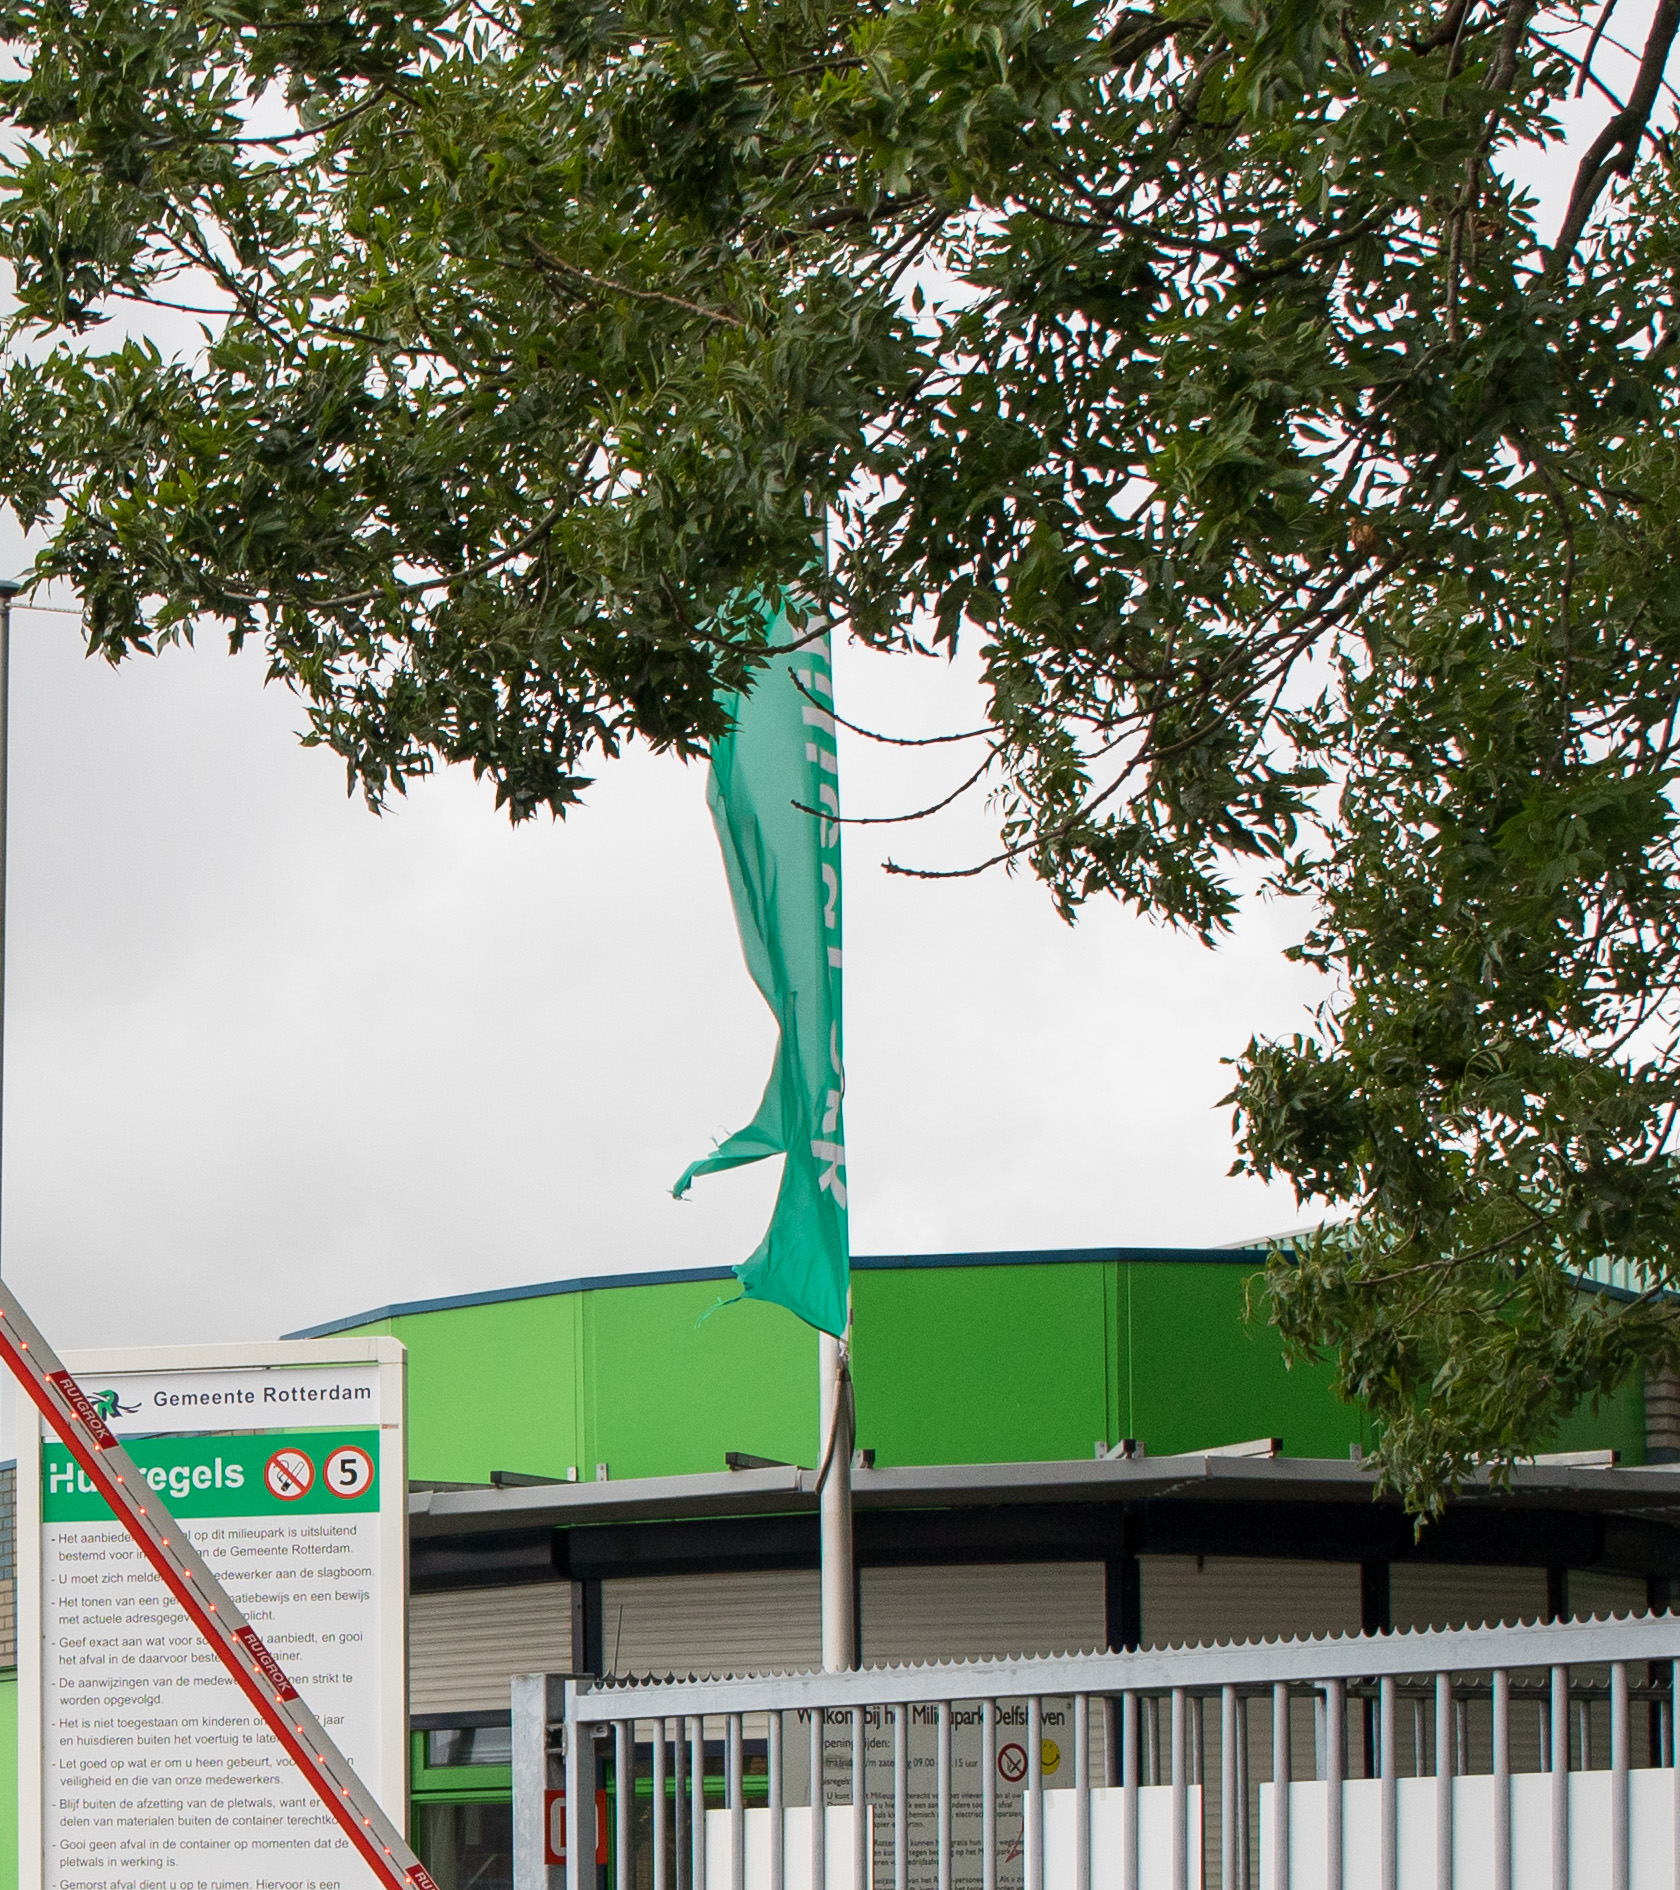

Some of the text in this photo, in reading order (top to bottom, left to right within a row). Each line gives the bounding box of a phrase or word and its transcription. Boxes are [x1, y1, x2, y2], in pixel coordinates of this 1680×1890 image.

[153, 1385, 371, 1407] Gemeente Rotterdam
[60, 1379, 109, 1438] RUIGROK
[339, 1459, 358, 1486] 5
[58, 1525, 357, 1544] Het aanbiede op dit milieupark uitsluitend
[58, 1550, 106, 1562] bestemd
[108, 1551, 134, 1560] voor
[230, 1546, 289, 1557] Gemeente
[292, 1544, 353, 1555] Rotterdam.
[71, 1567, 375, 1584] moet zich melde edewerker aan slagboom.
[58, 1597, 78, 1608] Het
[81, 1597, 112, 1607] tonen
[115, 1597, 136, 1607] van
[138, 1597, 160, 1606] een
[310, 1593, 332, 1602] een
[334, 1590, 370, 1603] bewijs
[58, 1615, 80, 1625] met
[82, 1614, 123, 1625] actuele
[59, 1637, 87, 1648] Geef
[89, 1637, 119, 1648] exact
[121, 1638, 143, 1647] aan
[145, 1636, 166, 1646] wat
[168, 1637, 193, 1646] voor
[266, 1633, 318, 1644] aanbiedt,
[338, 1632, 363, 1645] gooi
[59, 1655, 77, 1665] het
[79, 1654, 106, 1665] afval
[138, 1654, 188, 1664] daarvoor
[244, 1634, 291, 1692] RUIGROK
[59, 1677, 75, 1689] De
[78, 1678, 150, 1690] aanwijzingen
[152, 1678, 173, 1687] van
[312, 1673, 339, 1684] strikt
[60, 1694, 164, 1707] worden opgevolgd.
[59, 1718, 79, 1729] Het
[94, 1718, 114, 1729] niet
[117, 1718, 178, 1730] toegestaan
[181, 1718, 199, 1727] om
[202, 1716, 250, 1727] kinderen
[323, 1715, 345, 1727] jaar
[797, 1707, 856, 1725] Wlkom
[912, 1704, 984, 1731] Milipark
[76, 1733, 280, 1747] huisdieren buiten het voertuig late
[59, 1759, 77, 1769] Let
[79, 1759, 108, 1772] goed
[127, 1758, 148, 1769] wat
[195, 1757, 224, 1768] heen
[226, 1757, 272, 1770] gebeurt,
[60, 1774, 283, 1789] veiligheid die van onze medewerkers.
[59, 1798, 307, 1812] Blijf buiten afzetting van pletwals, want
[59, 1816, 90, 1827] delen
[93, 1818, 114, 1827] van
[116, 1816, 175, 1827] materialen
[178, 1816, 212, 1826] buiten
[232, 1816, 284, 1826] container
[60, 1838, 332, 1852] Gooi geen afval container op momenten dat
[60, 1857, 105, 1869] pletwals
[120, 1857, 164, 1869] werking
[59, 1880, 108, 1890] Gemorst
[110, 1879, 136, 1890] afval
[139, 1880, 167, 1890] dient
[211, 1881, 252, 1890] ruimen.
[256, 1879, 304, 1890] Hiervoor
[319, 1881, 341, 1890] een
